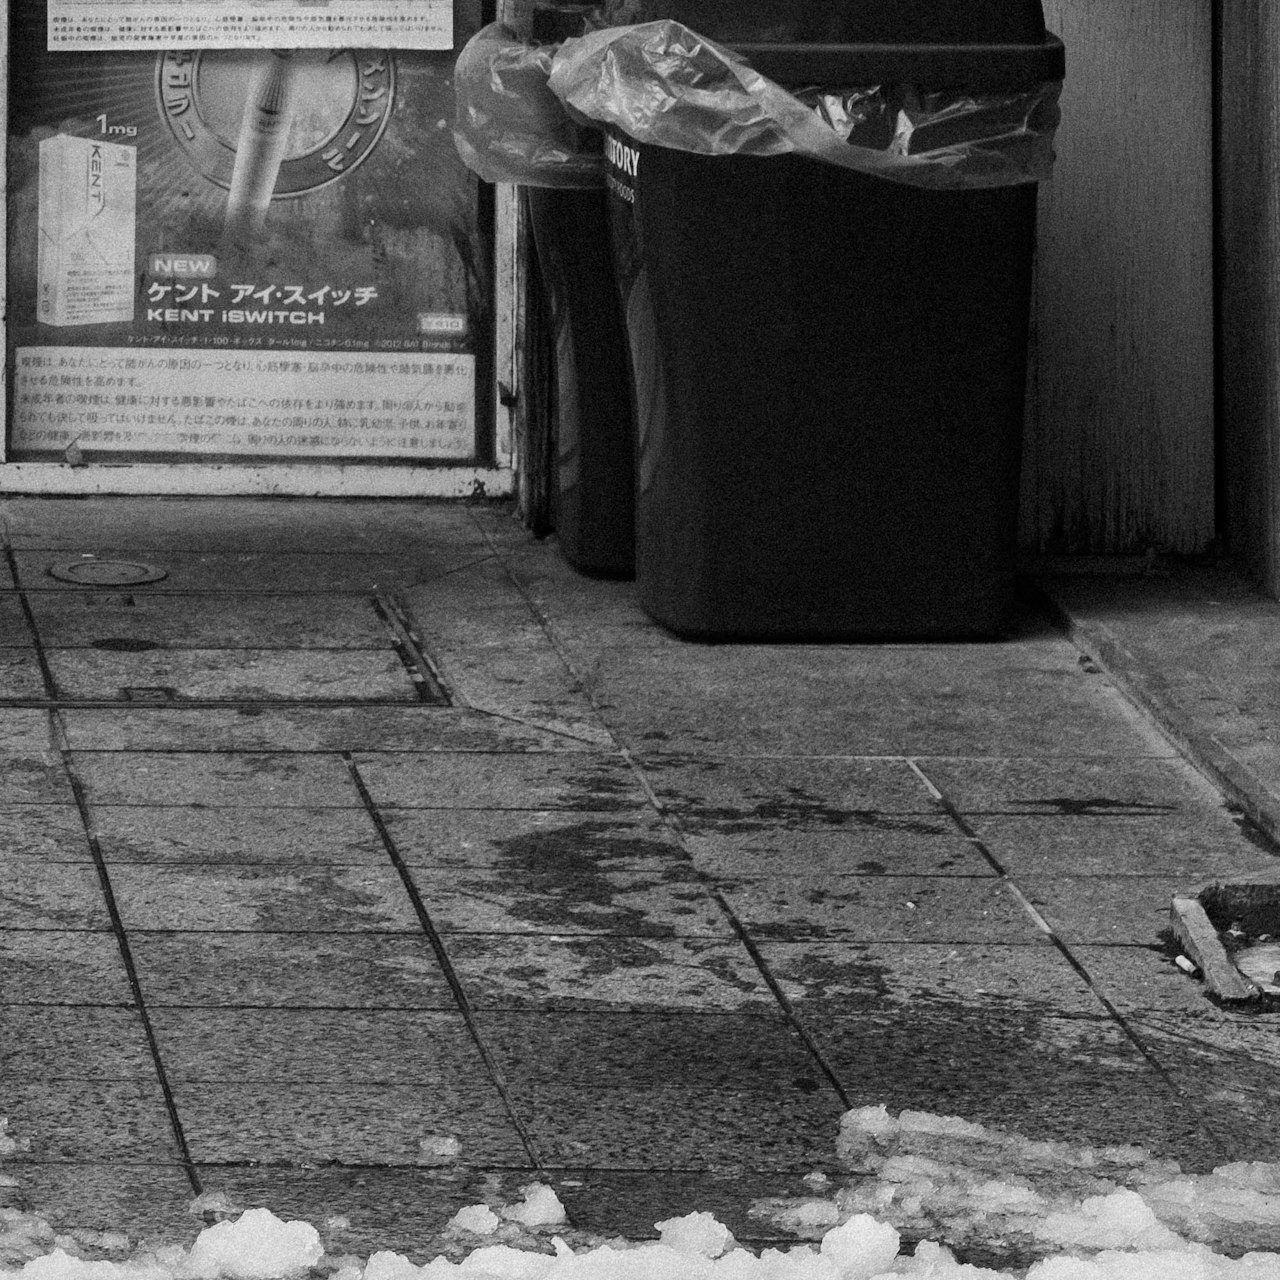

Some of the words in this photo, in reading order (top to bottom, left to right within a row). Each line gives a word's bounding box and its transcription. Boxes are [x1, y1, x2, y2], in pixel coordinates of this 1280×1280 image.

[95, 112, 138, 137] 1mg
[322, 62, 385, 171] メンソール
[89, 143, 106, 204] KENT
[154, 258, 211, 273] NEW
[146, 281, 221, 303] ケント
[230, 282, 379, 305] アイ・スイッチ
[146, 308, 215, 323] KENT
[221, 308, 326, 325] iSWITCH
